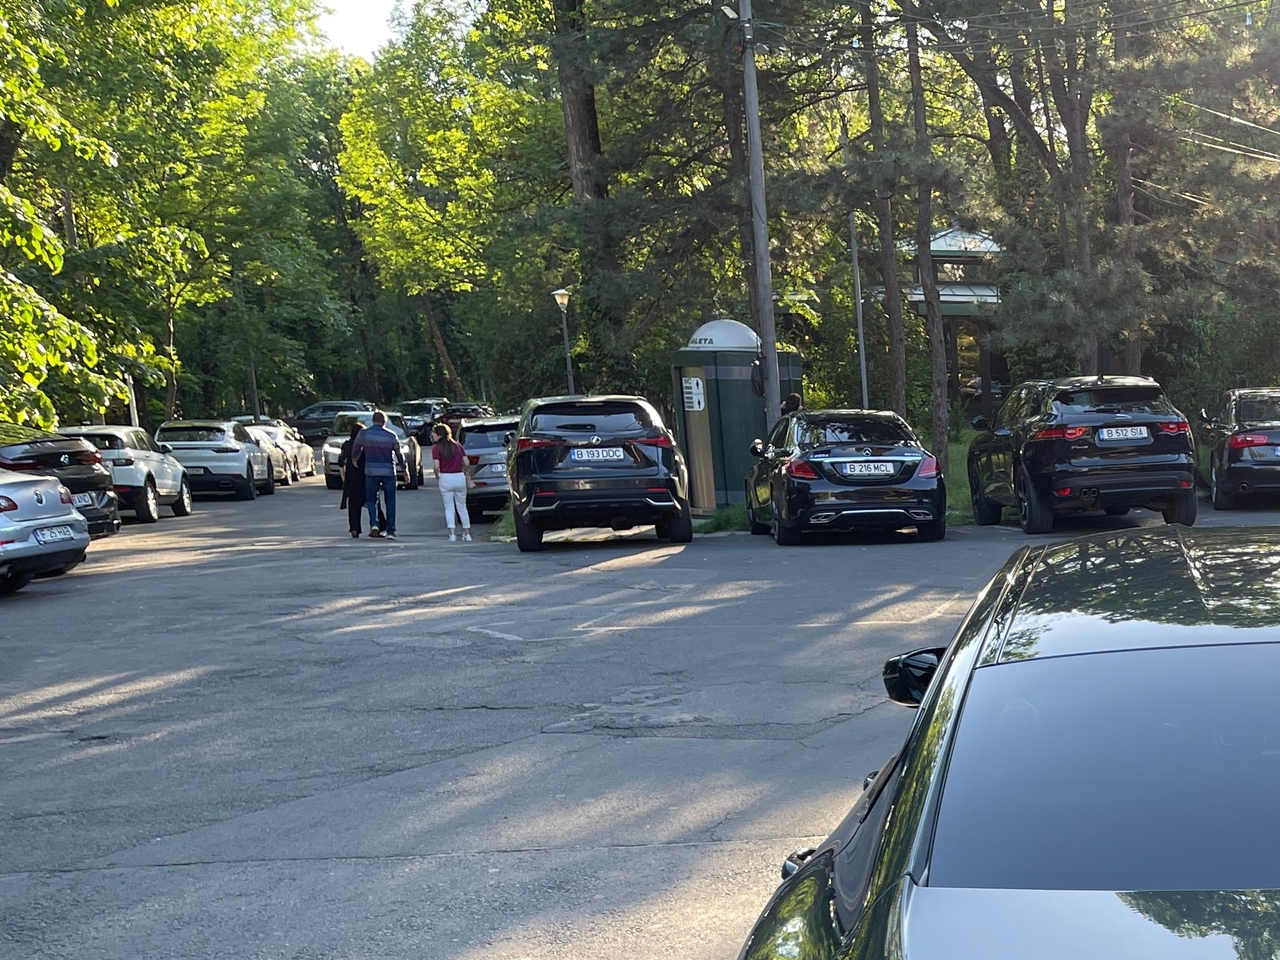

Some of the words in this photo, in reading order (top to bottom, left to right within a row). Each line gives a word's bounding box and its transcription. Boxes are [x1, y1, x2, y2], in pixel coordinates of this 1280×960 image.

[1115, 429, 1128, 437] 512
[1131, 428, 1144, 436] SIA
[576, 450, 584, 458] B
[586, 449, 600, 458] 193
[601, 449, 621, 458] DDC
[849, 464, 856, 472] B
[859, 463, 872, 472] 216
[874, 462, 890, 472] MCL
